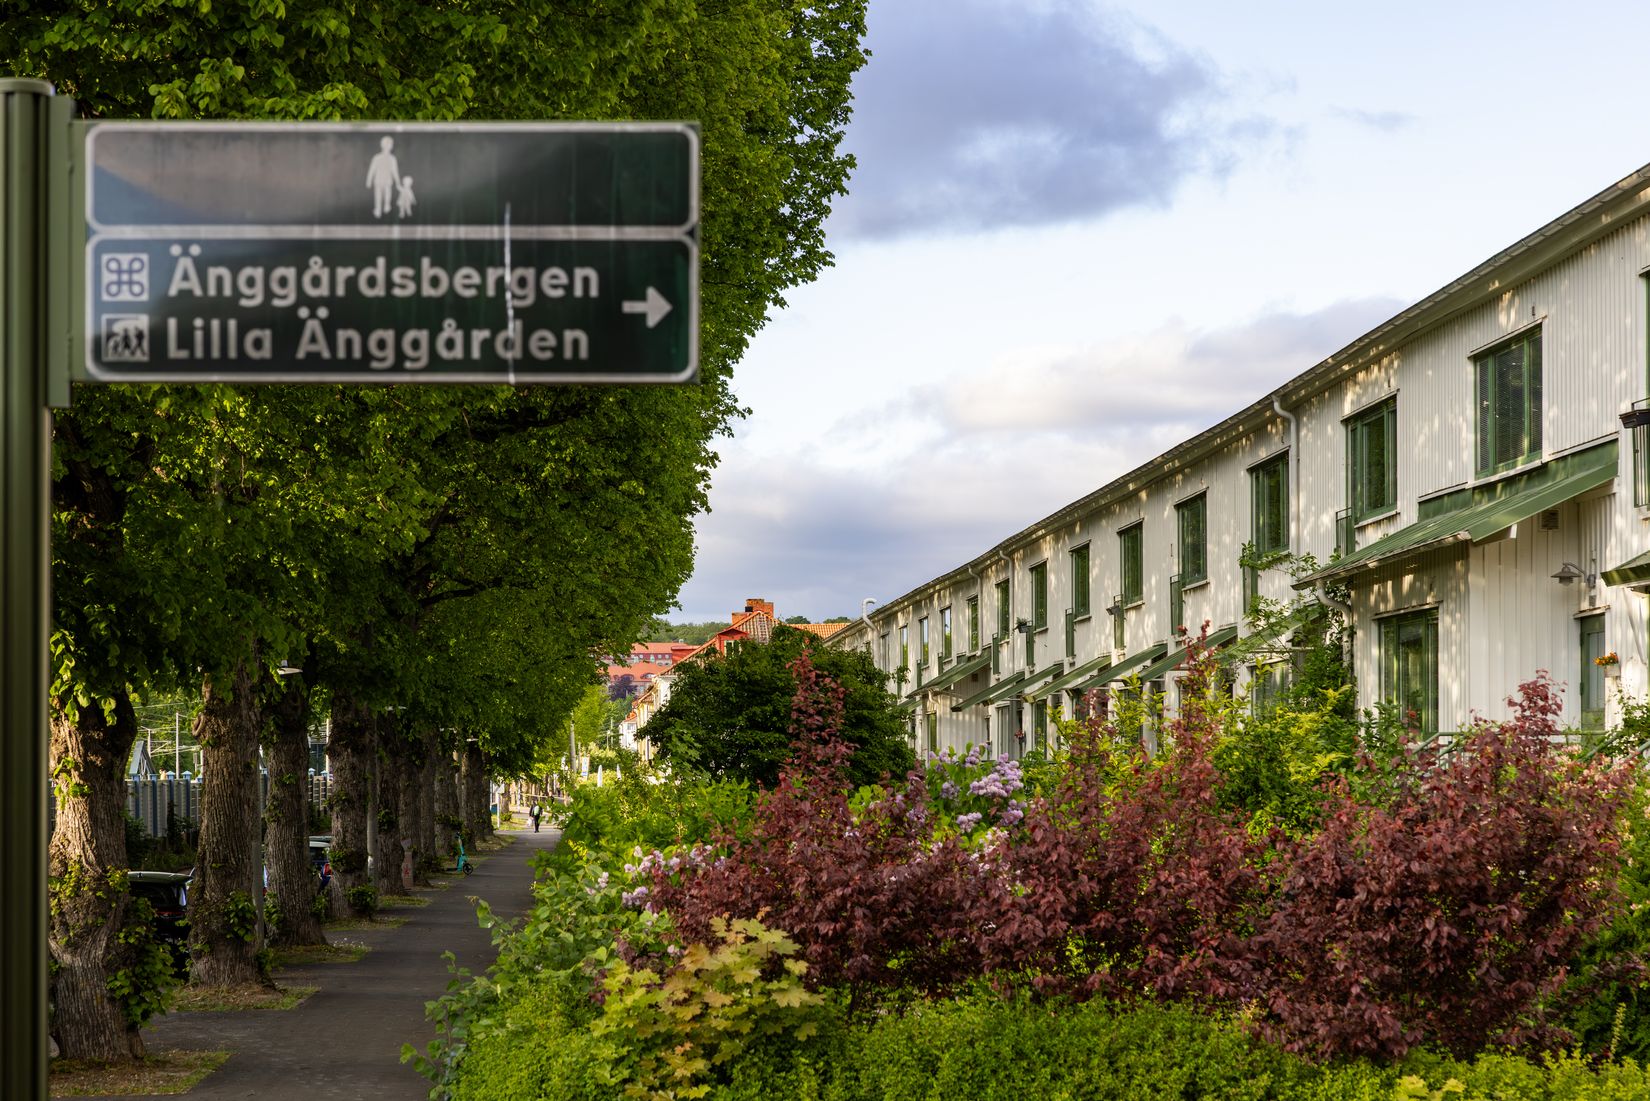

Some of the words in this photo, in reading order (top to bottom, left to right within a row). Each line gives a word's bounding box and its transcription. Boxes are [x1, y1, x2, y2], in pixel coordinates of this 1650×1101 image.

[167, 244, 600, 307] Änggårdsbergen
[167, 317, 272, 360] Lilla
[295, 306, 589, 369] Änggården
